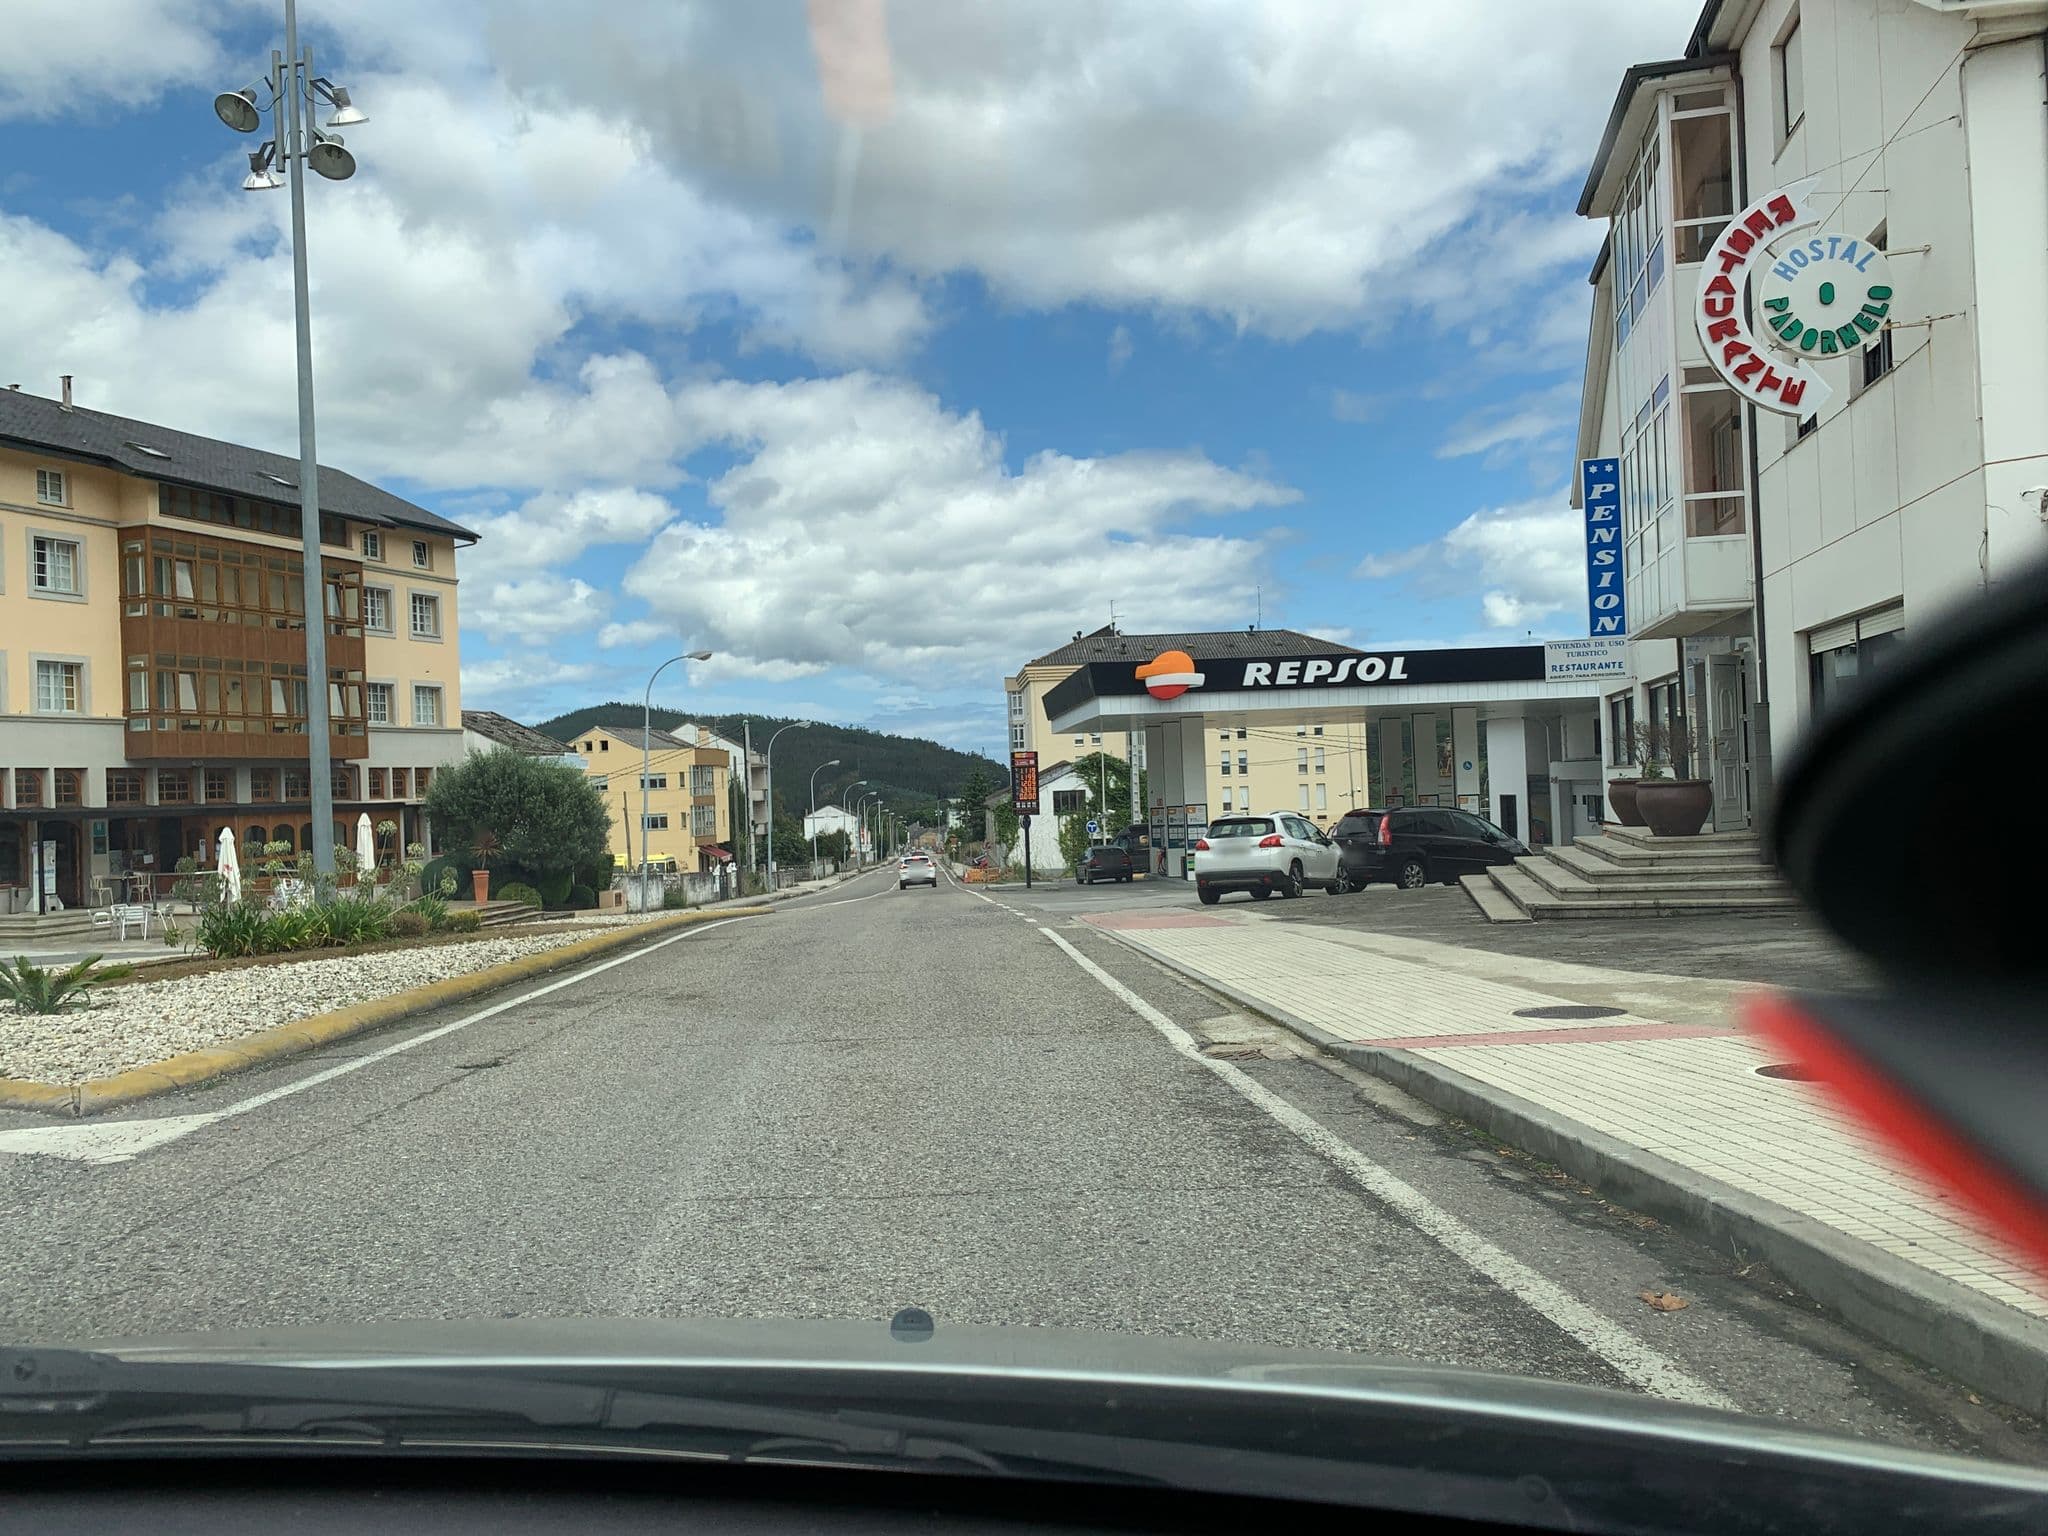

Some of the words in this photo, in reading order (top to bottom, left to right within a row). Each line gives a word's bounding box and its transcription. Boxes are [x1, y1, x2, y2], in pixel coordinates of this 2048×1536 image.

[1772, 237, 1876, 282] HOSTAL
[1704, 194, 1806, 406] RESTAURANTE
[1764, 285, 1893, 354] PADORNELO
[1588, 483, 1623, 632] PENSION
[1549, 642, 1591, 650] VIVIENDAS
[1566, 650, 1608, 658] TURISTICO
[1242, 656, 1409, 687] REPSOL
[1551, 662, 1624, 672] RESTAURANTE
